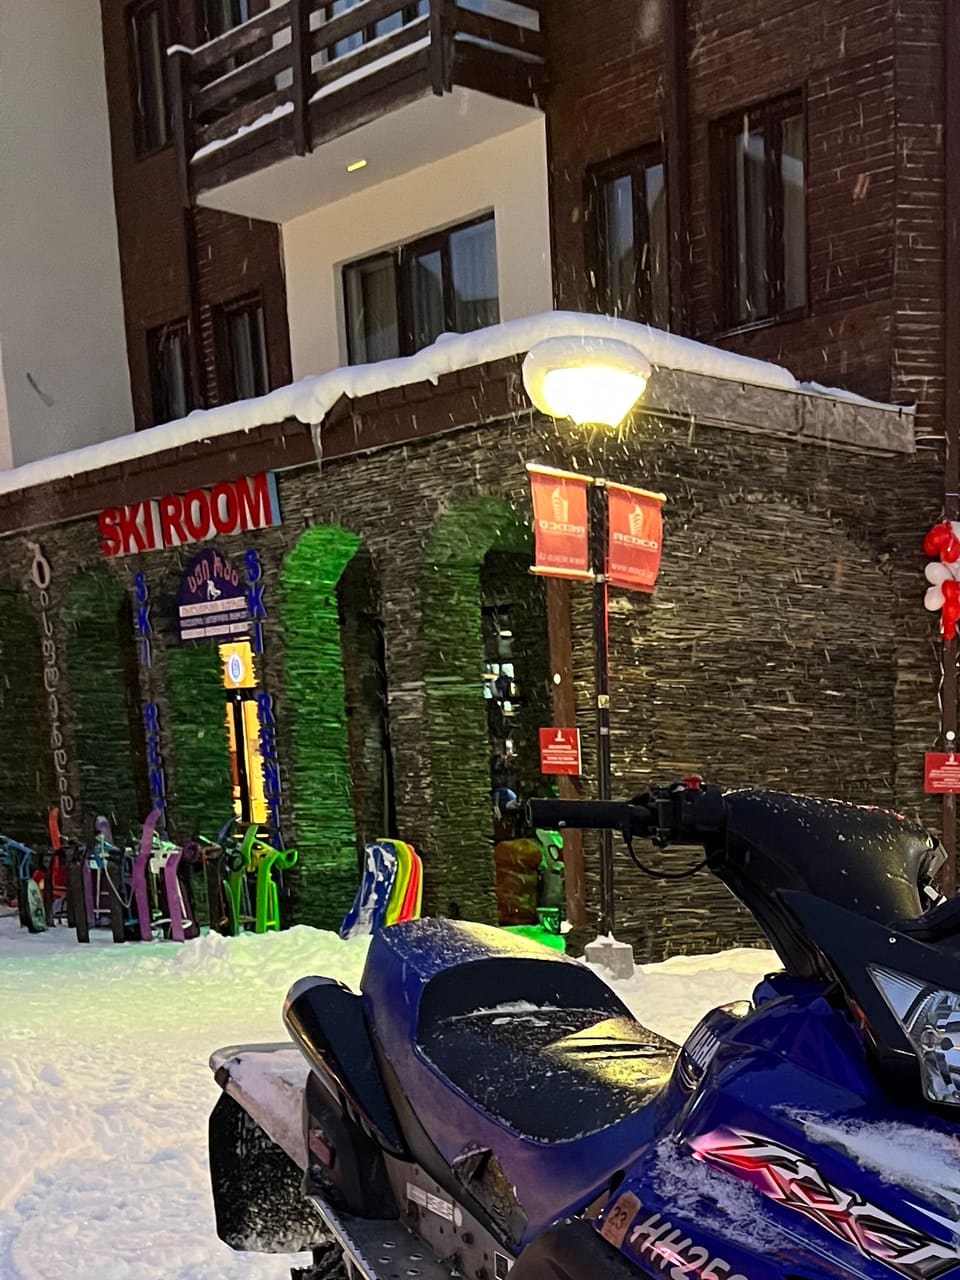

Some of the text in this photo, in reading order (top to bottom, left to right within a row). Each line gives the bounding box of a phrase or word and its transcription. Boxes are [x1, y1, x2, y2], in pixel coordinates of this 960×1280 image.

[98, 470, 280, 559] SKI ROOM
[134, 571, 152, 668] SKI
[244, 549, 267, 654] SKI
[608, 1206, 628, 1230] 23
